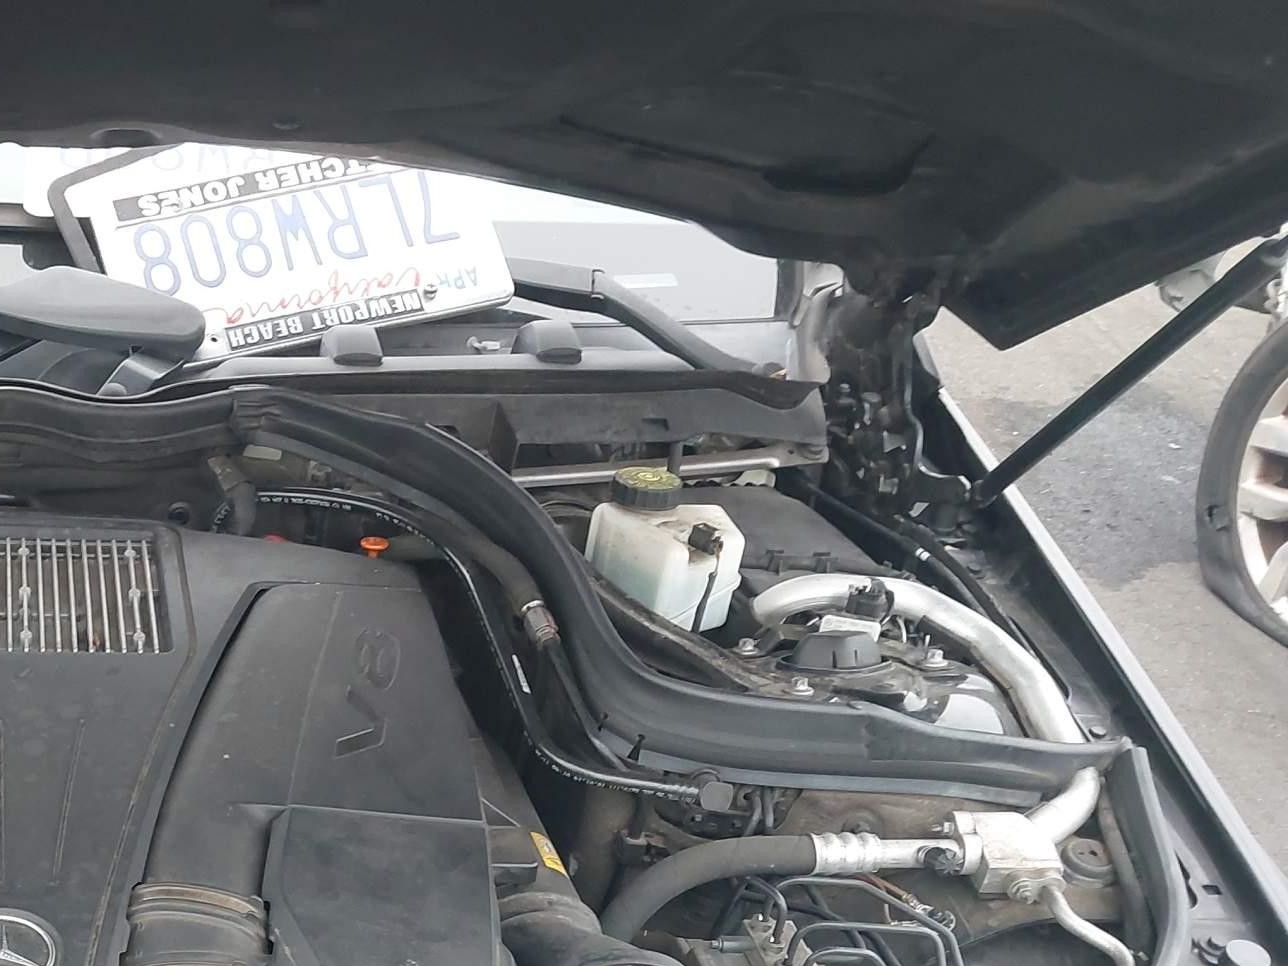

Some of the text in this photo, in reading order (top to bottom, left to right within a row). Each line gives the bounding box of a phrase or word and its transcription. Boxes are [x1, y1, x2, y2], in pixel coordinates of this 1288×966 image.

[137, 176, 246, 217] JONES
[133, 170, 460, 297] 7LRW808
[226, 291, 422, 348] NEWPORT BEACH
